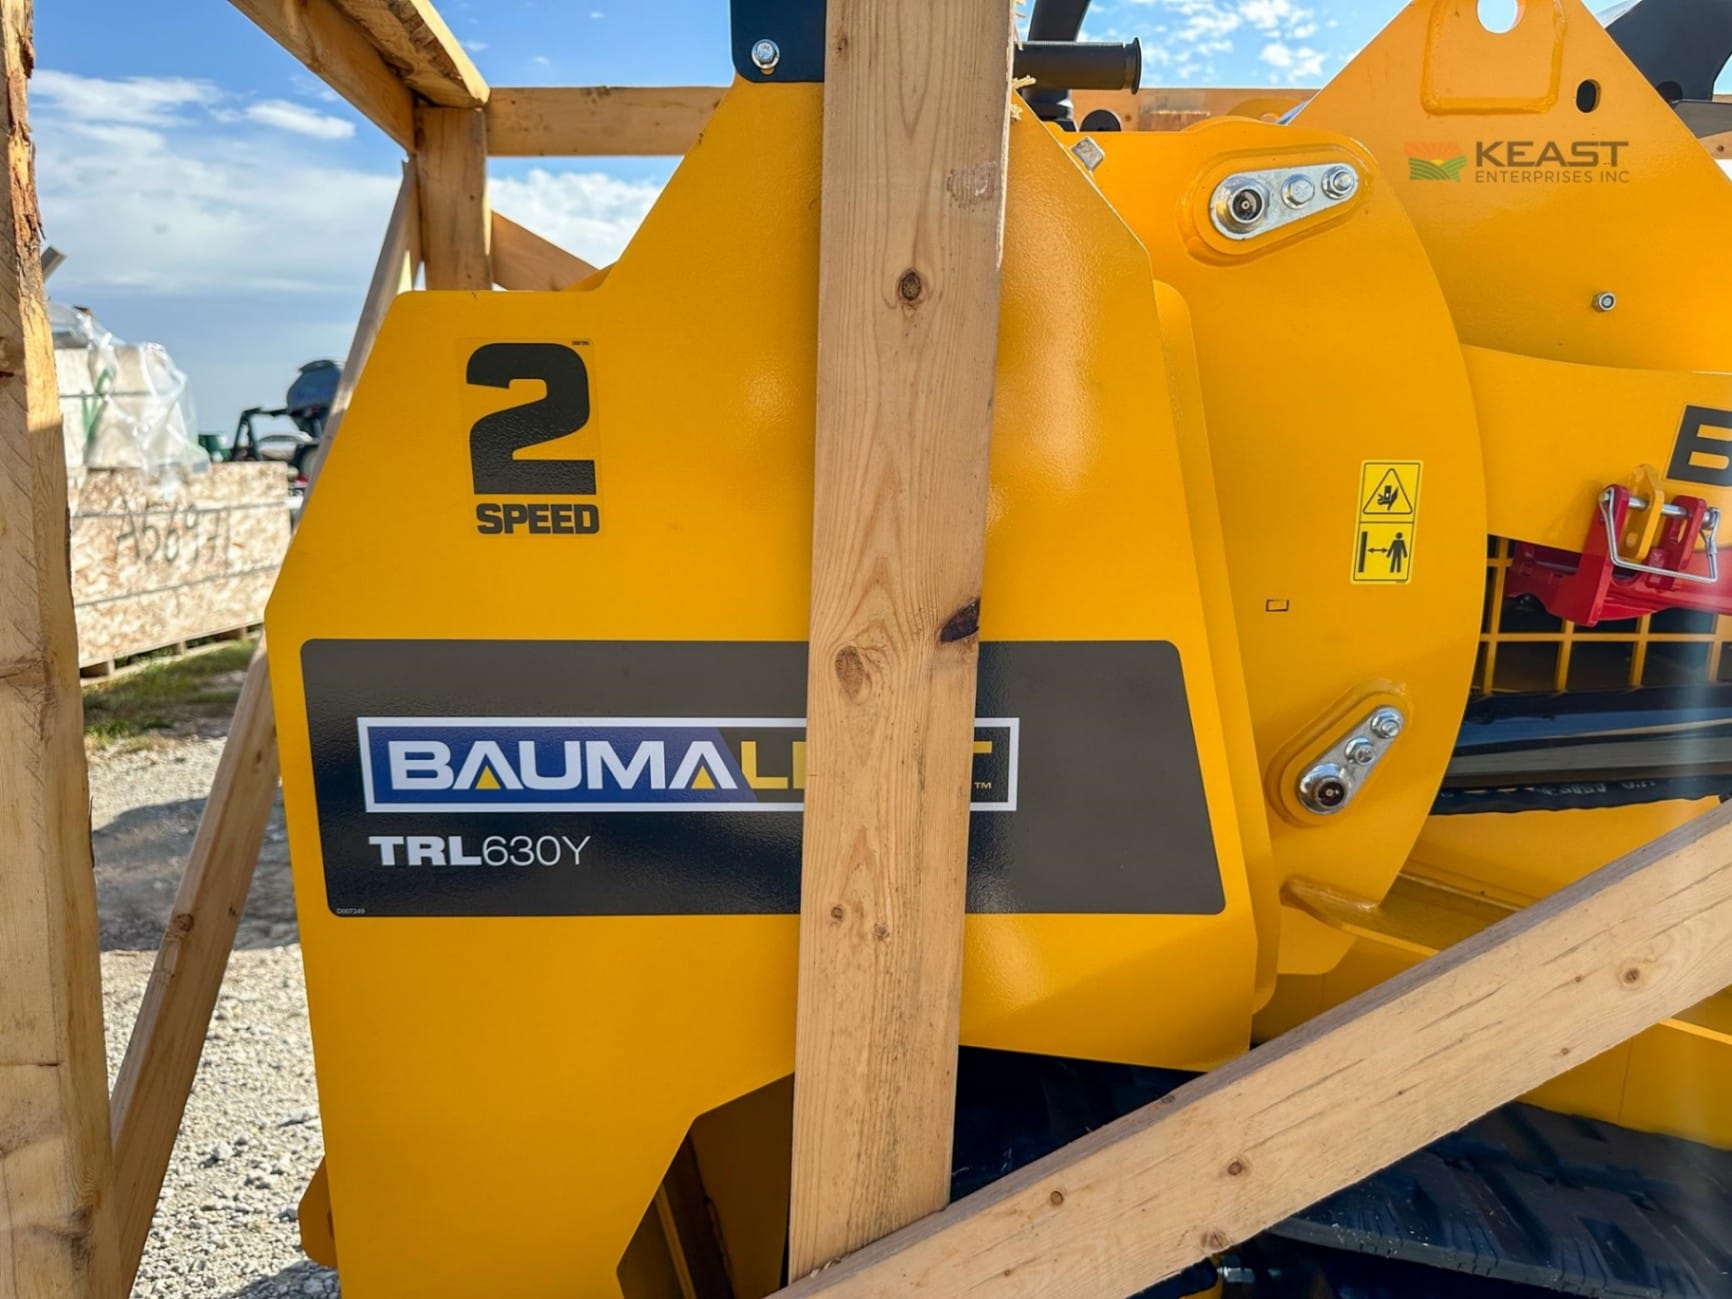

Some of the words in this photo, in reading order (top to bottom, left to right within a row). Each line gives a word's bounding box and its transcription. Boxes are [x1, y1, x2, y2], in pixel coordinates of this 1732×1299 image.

[466, 342, 597, 495] 2
[476, 503, 600, 535] SPEED
[368, 834, 592, 867] TRL630Y
